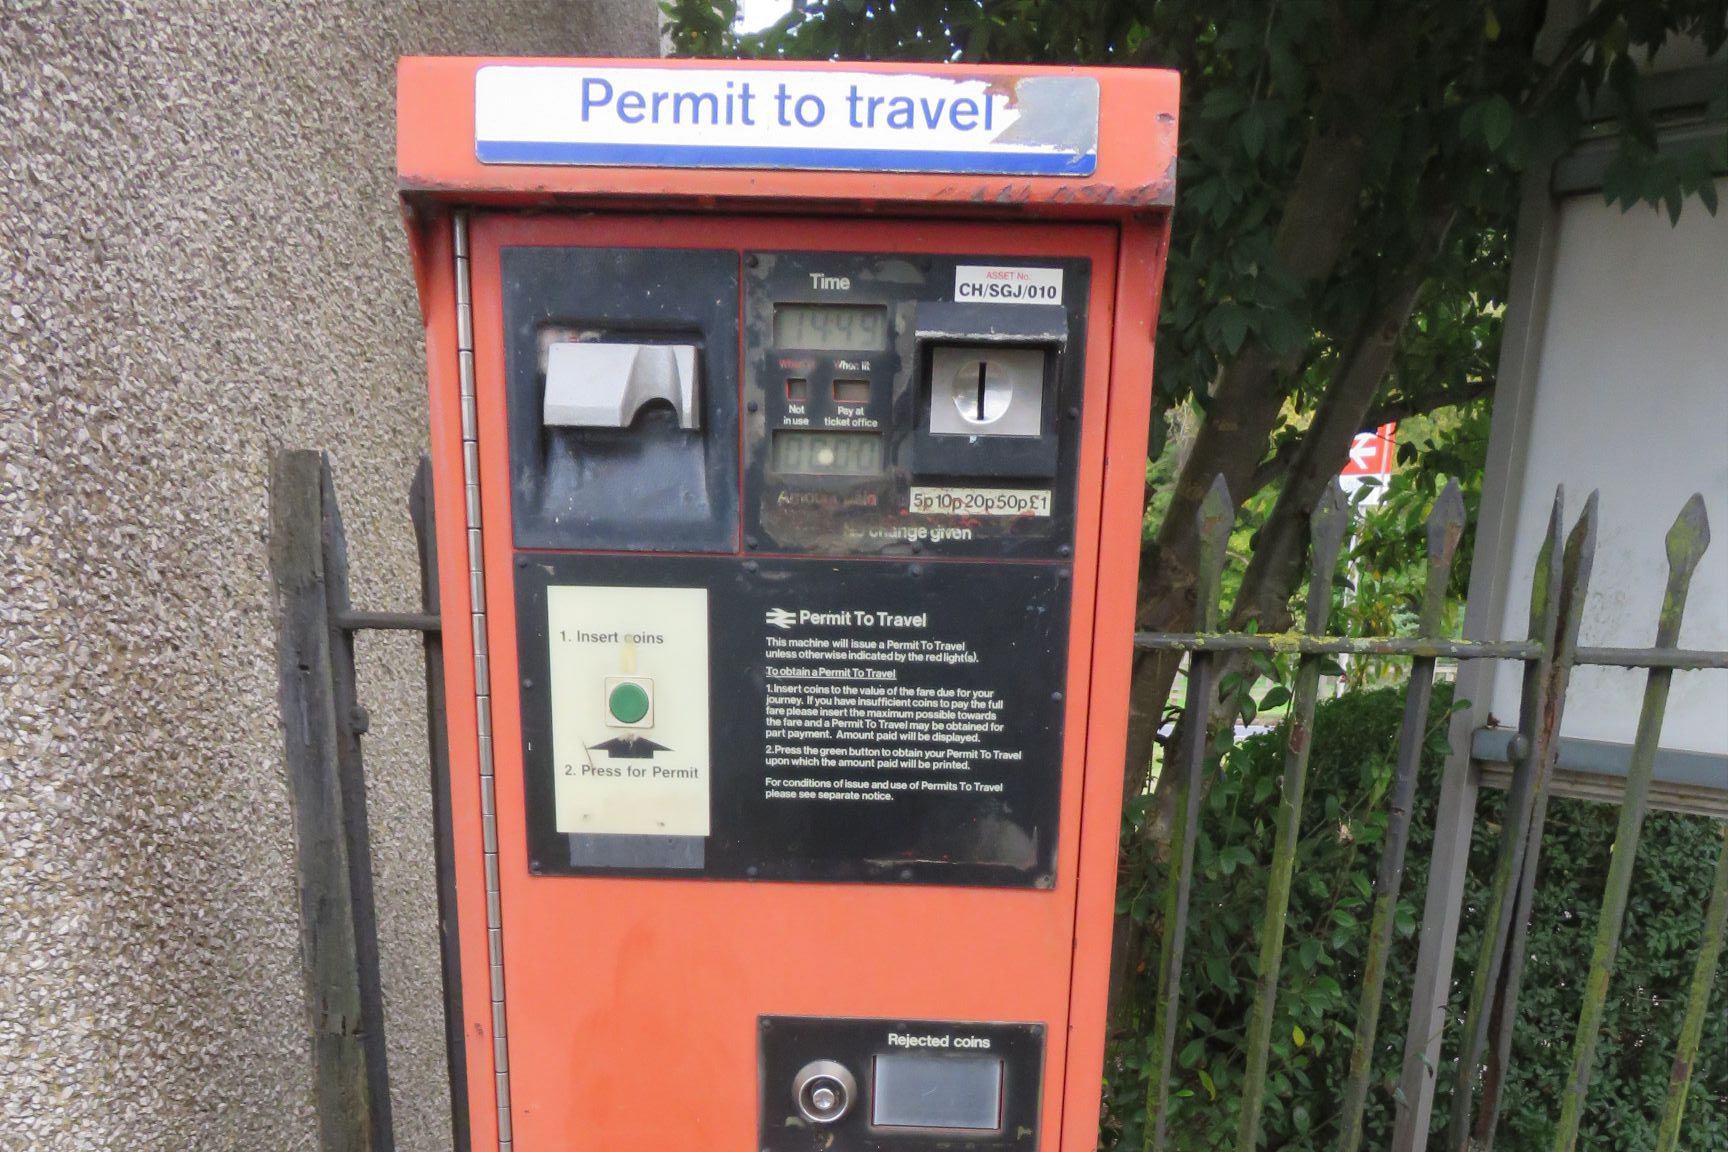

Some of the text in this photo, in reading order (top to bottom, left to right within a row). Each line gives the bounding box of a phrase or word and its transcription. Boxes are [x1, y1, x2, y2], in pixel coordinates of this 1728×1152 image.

[581, 77, 992, 132] Permit to travel
[809, 273, 850, 290] Time
[986, 271, 1031, 280] ASSET No.
[959, 282, 1057, 299] CH/SGJ/010
[861, 360, 871, 370] lit
[789, 404, 805, 414] Not
[838, 406, 864, 417] Pay at
[783, 416, 809, 425] in use
[824, 417, 878, 427] ticket office
[930, 525, 972, 543] given
[800, 610, 926, 627] Permit To Travel
[560, 630, 664, 644] 1. Insert coins
[766, 637, 786, 647] This
[789, 637, 829, 648] machine
[832, 639, 848, 648] will
[851, 639, 877, 649] issue
[887, 640, 919, 650] Permit
[921, 641, 933, 650] To
[934, 641, 965, 651] Travel
[766, 649, 979, 664] unless otherwise indicated by the red light(s).
[766, 666, 896, 678] To obtain a Permit To Travel
[804, 684, 830, 694] coins
[831, 686, 841, 694] to
[843, 685, 858, 695] the
[860, 686, 885, 695] value
[887, 686, 897, 695] of
[899, 687, 914, 696] the
[916, 687, 935, 696] fare
[937, 688, 955, 697] due
[957, 688, 971, 697] for
[973, 690, 994, 699] your
[766, 694, 1003, 710] journey. If you have insufficient coins to pay the full
[766, 706, 996, 720] fare please insert the maximum possible towards
[766, 717, 1004, 732] the fare and a Permit To Travel may be obtained for
[766, 729, 980, 743] part payment. Amount paid will be displayed.
[803, 746, 818, 754] the
[820, 747, 847, 757] green
[849, 747, 880, 756] button
[882, 748, 891, 756] to
[892, 748, 923, 757] obtain
[924, 750, 946, 759] your
[947, 749, 978, 759] Permit
[980, 750, 992, 759] To
[993, 750, 1022, 760] Travel
[766, 757, 970, 770] upon which the amount paid will be printed.
[564, 764, 698, 779] 2. Press for Permit
[765, 778, 1003, 792] For conditions of issue and use of Permits To Travel
[766, 789, 894, 800] please see separate notice.
[888, 1033, 991, 1048] Rejected coins
